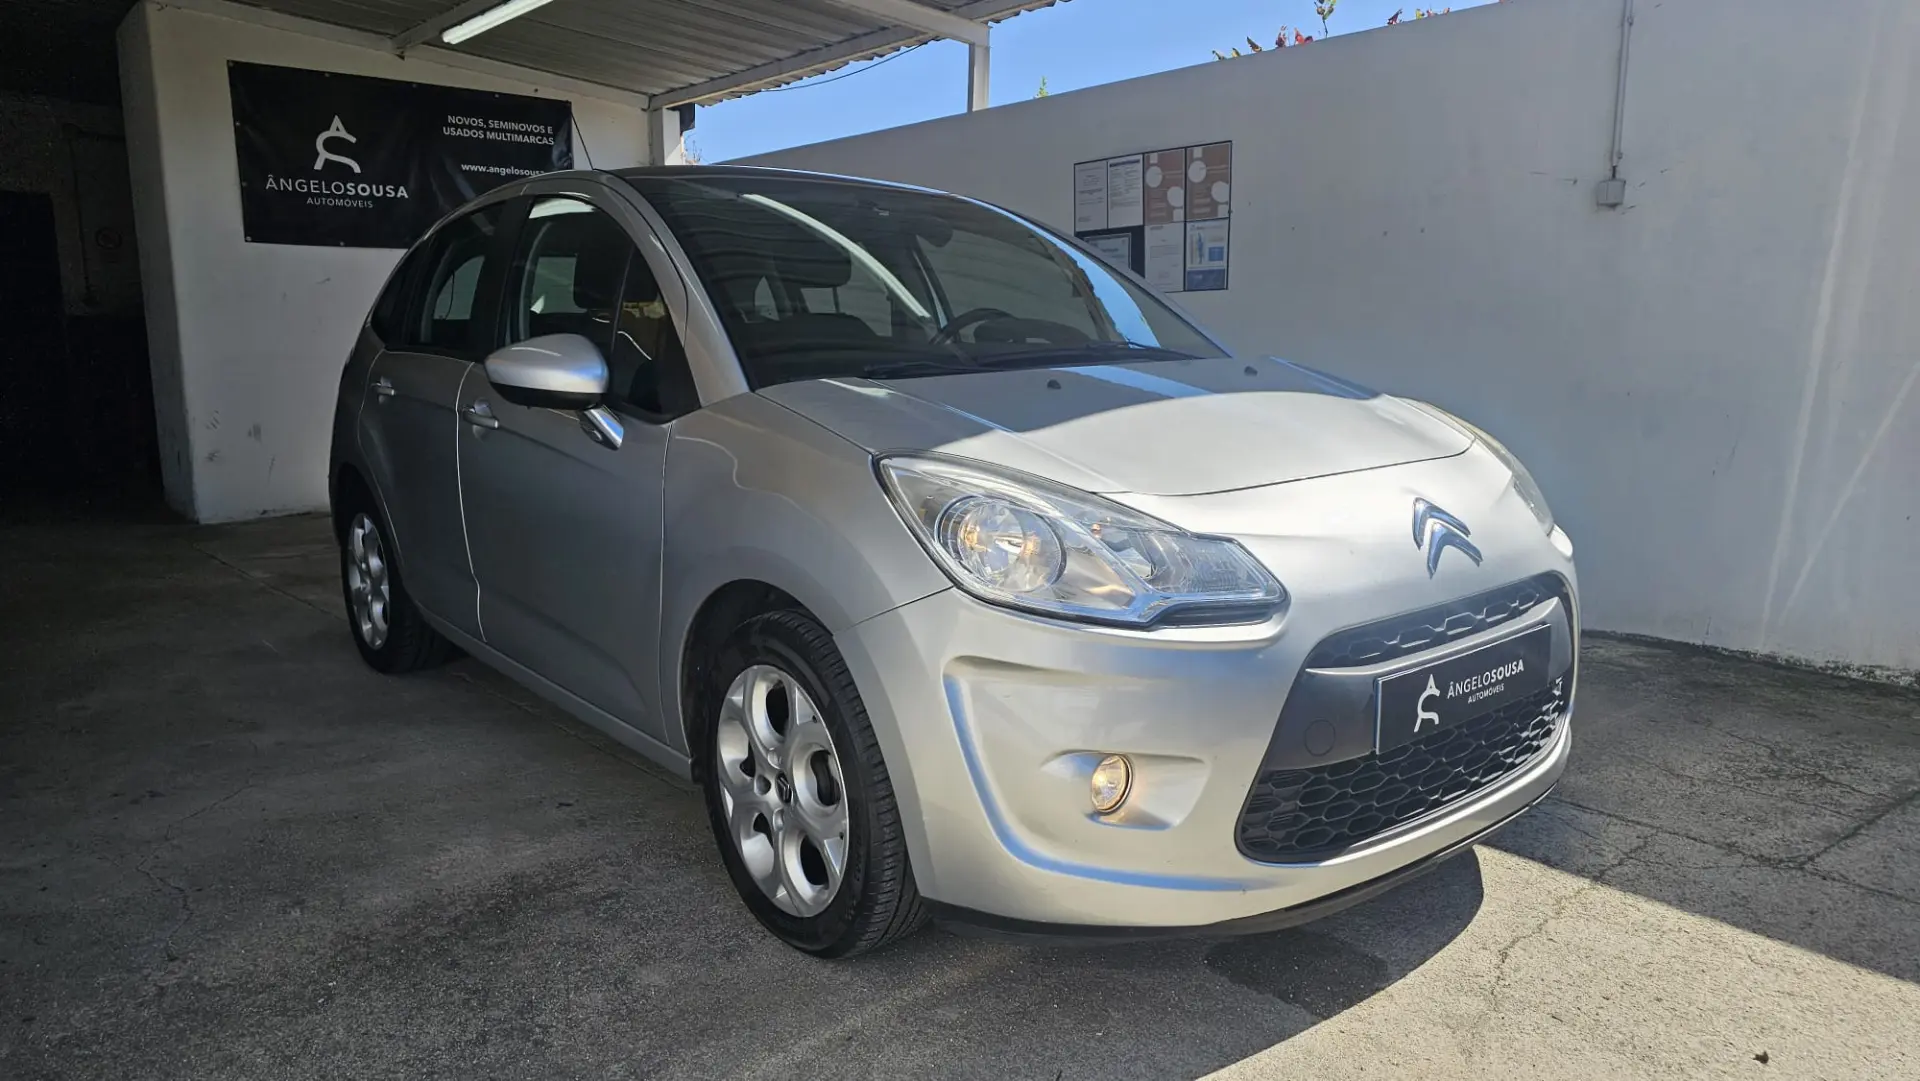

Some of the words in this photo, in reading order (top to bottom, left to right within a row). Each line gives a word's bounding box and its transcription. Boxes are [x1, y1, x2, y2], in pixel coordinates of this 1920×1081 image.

[447, 115, 487, 128] NOVOS,
[488, 119, 546, 134] SEMINOVOS
[547, 126, 553, 135] E
[442, 126, 485, 139] USADOS
[486, 131, 555, 146] MULTIMARCAS
[265, 174, 409, 199] ÂNGELOSOUSA
[306, 196, 374, 209] AUTOMÓVEIS
[1447, 659, 1525, 700] ÂNGELOSOUSA
[1467, 683, 1505, 704] AUTOMÓVEIS
